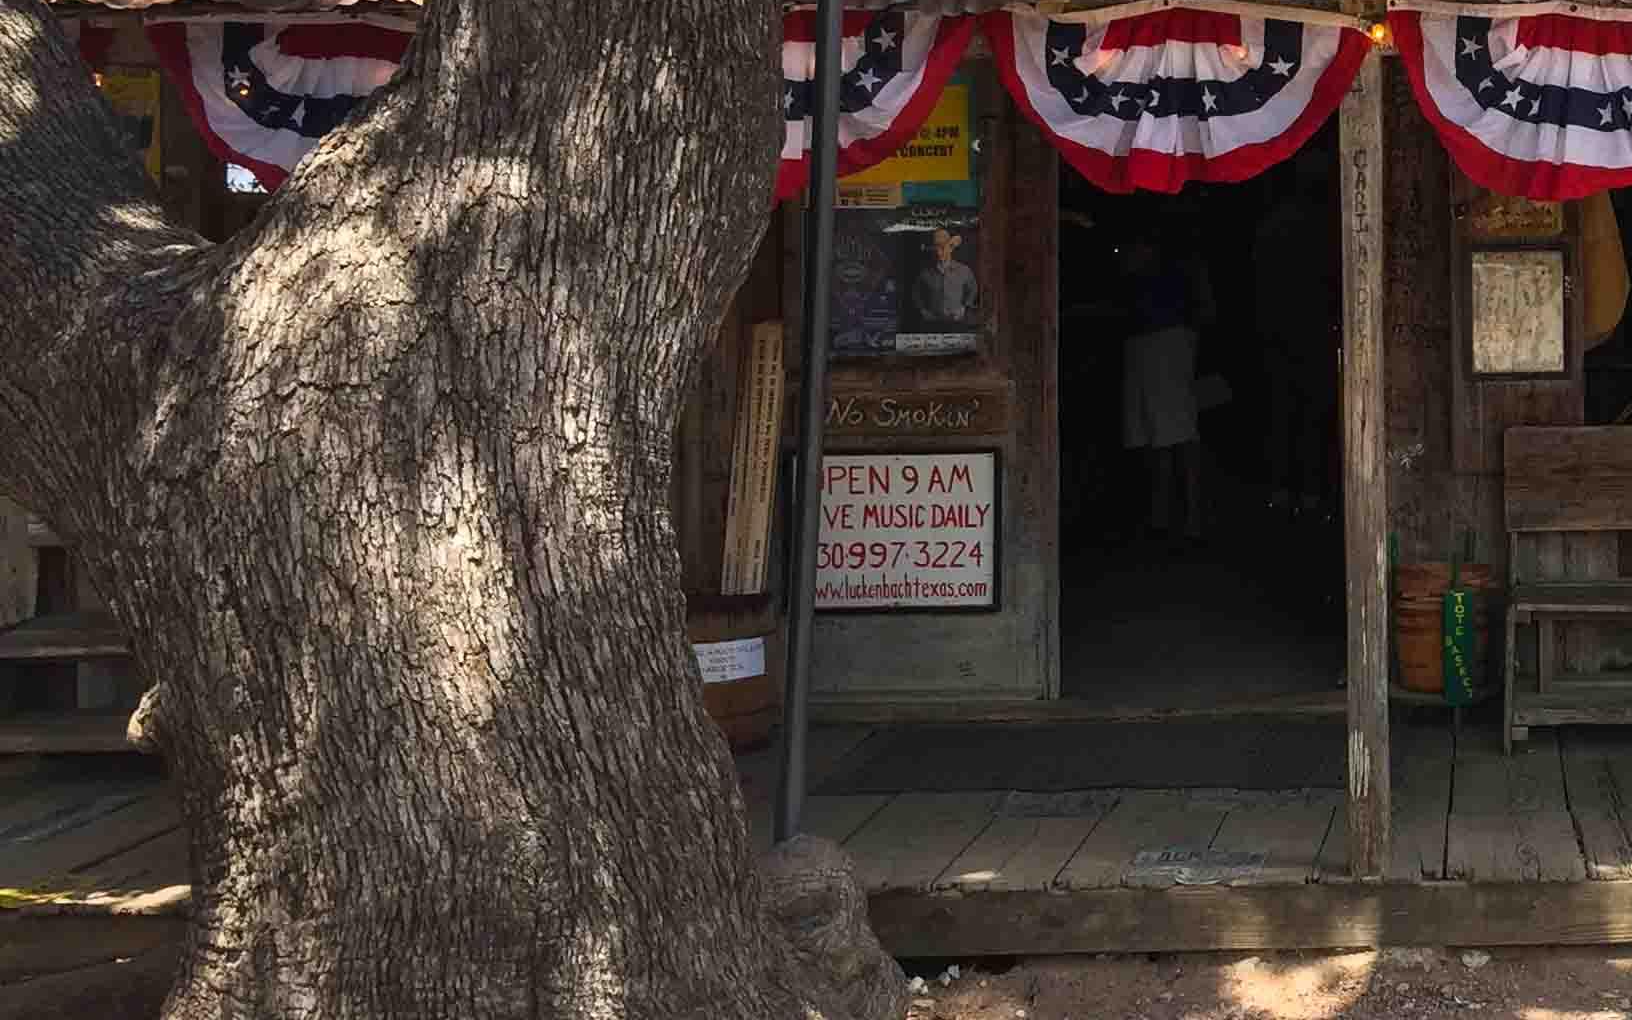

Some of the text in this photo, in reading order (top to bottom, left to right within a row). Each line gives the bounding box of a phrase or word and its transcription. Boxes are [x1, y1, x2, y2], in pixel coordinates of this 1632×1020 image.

[901, 465, 919, 494] 9
[927, 464, 974, 493] AM
[823, 503, 991, 529] VE MUSIC DAILY
[815, 572, 988, 599] ww.luckenbachtexas.com
